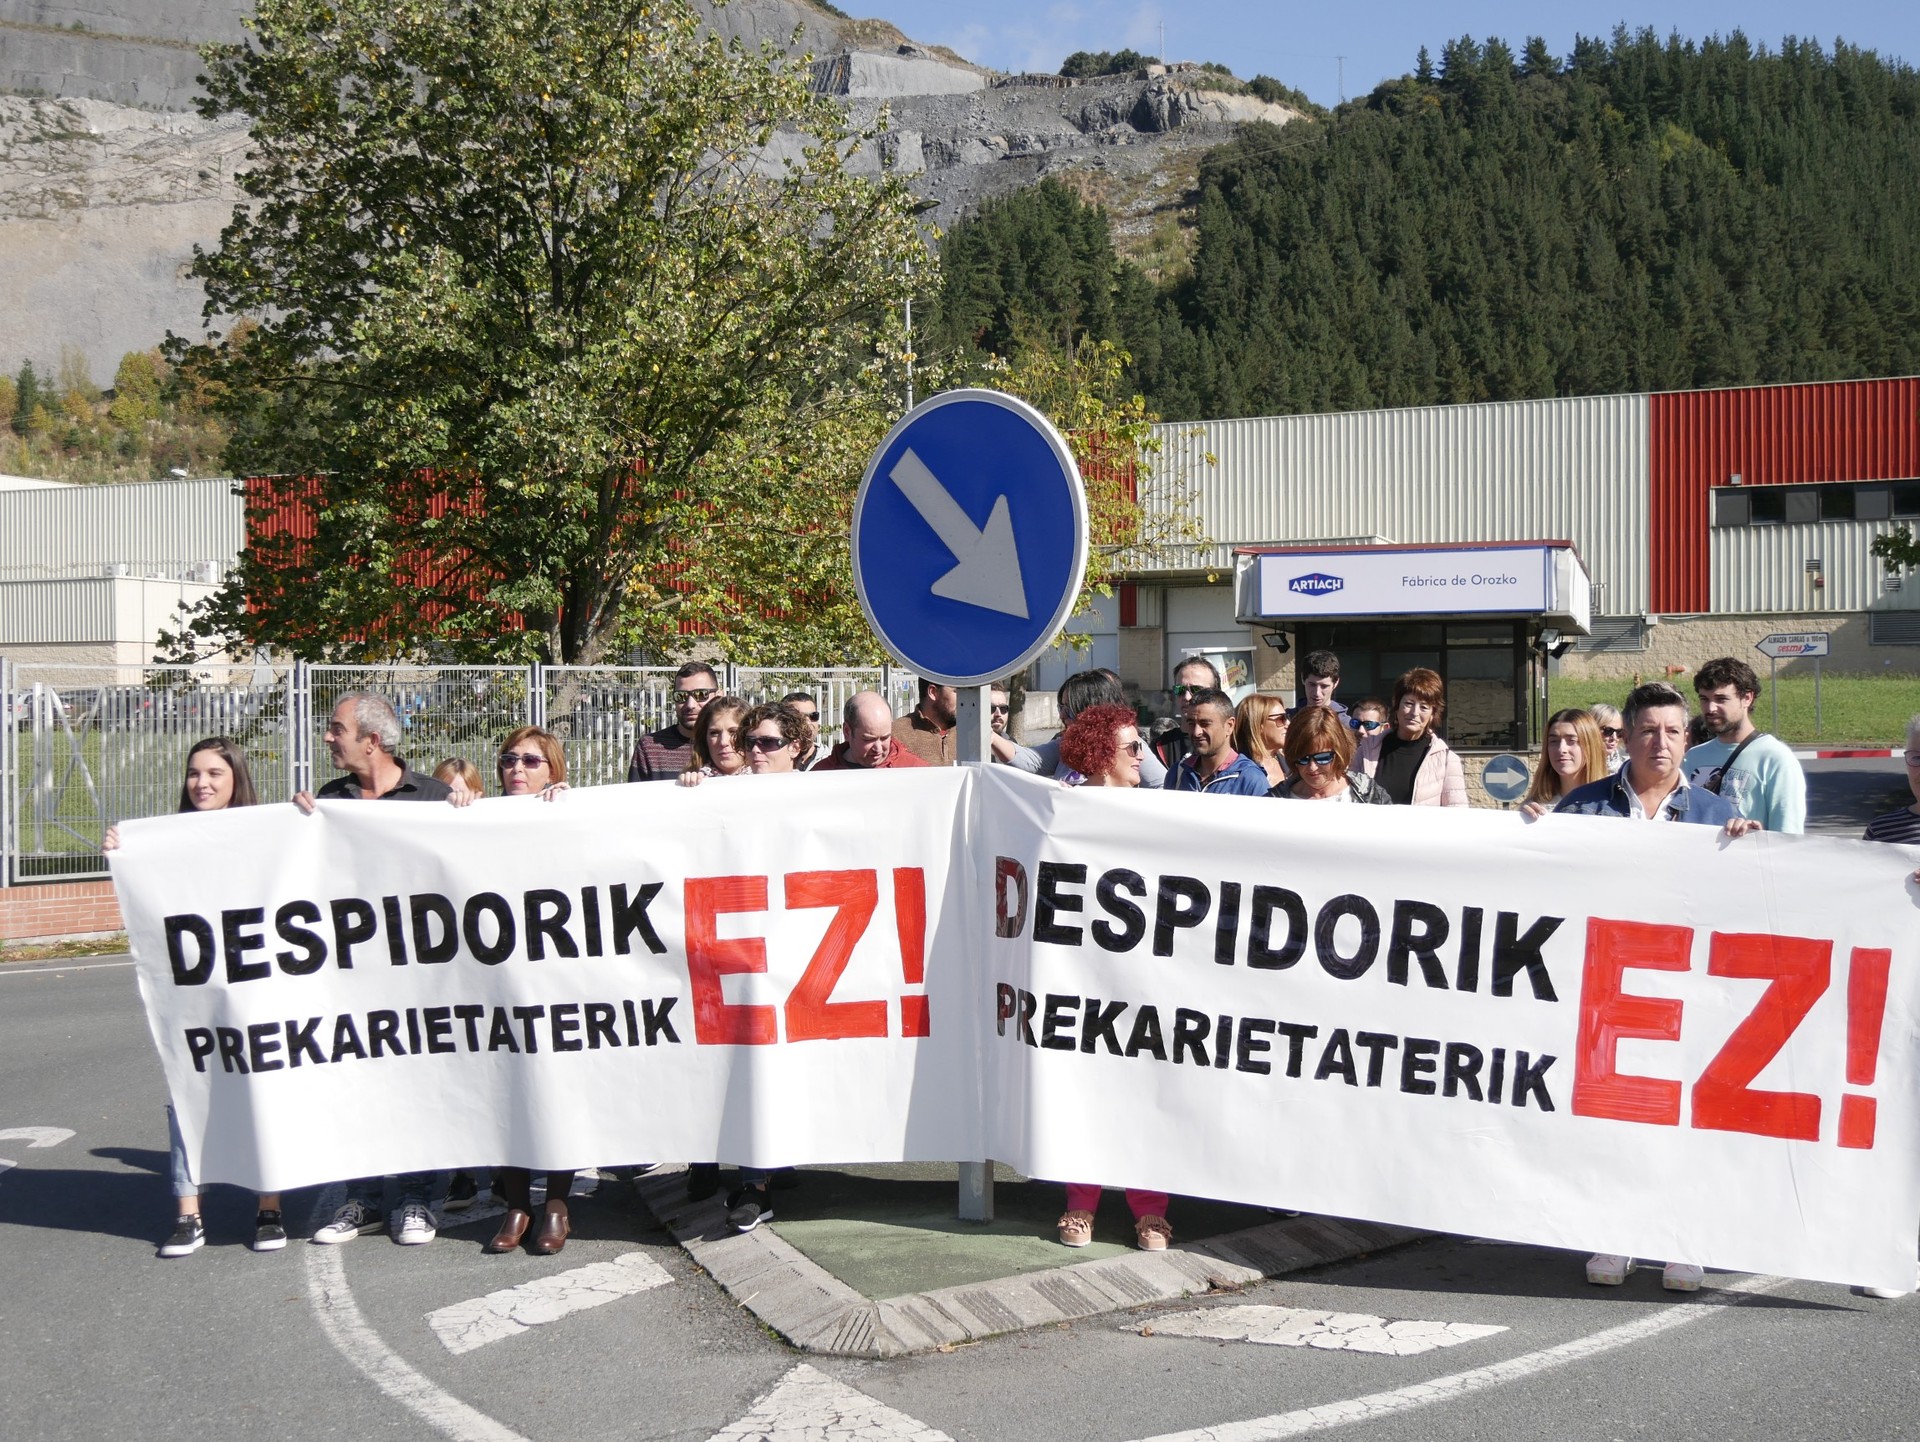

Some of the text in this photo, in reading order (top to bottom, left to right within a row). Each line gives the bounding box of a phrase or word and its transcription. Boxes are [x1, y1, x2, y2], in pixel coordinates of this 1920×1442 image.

[1291, 576, 1342, 592] ARTIACH
[1402, 573, 1517, 587] Fábrica de Orozko
[164, 882, 668, 986] DESPIDORIK
[684, 867, 930, 1046] EZ!
[995, 856, 1565, 1003] DESPIDORIK
[184, 997, 681, 1075] PREKARIETATERIK
[996, 982, 1557, 1112] PREKARIETATERIK
[1571, 916, 1892, 1150] EZ!
